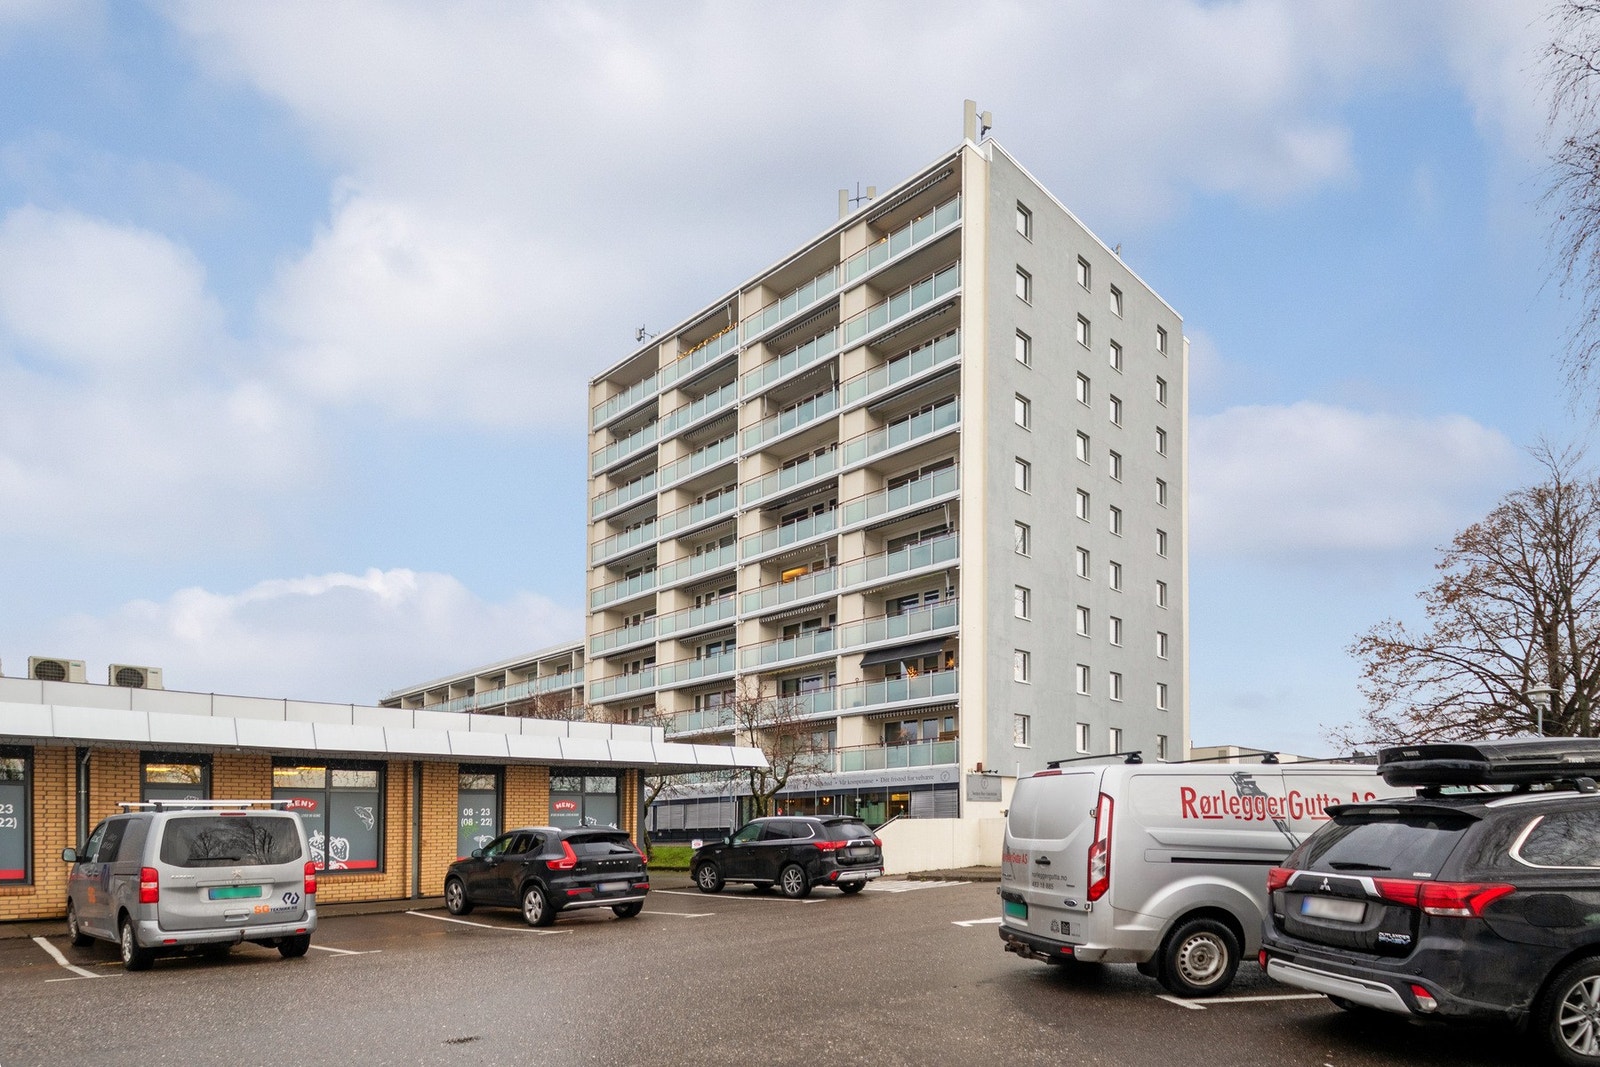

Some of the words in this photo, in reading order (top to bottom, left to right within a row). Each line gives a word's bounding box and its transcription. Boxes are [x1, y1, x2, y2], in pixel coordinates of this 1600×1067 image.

[0, 804, 14, 814] 23
[555, 801, 575, 809] MENY
[463, 808, 474, 816] 08
[480, 808, 491, 816] 23
[461, 818, 474, 827] (08
[480, 818, 493, 827] 22)
[254, 904, 270, 914] SG
